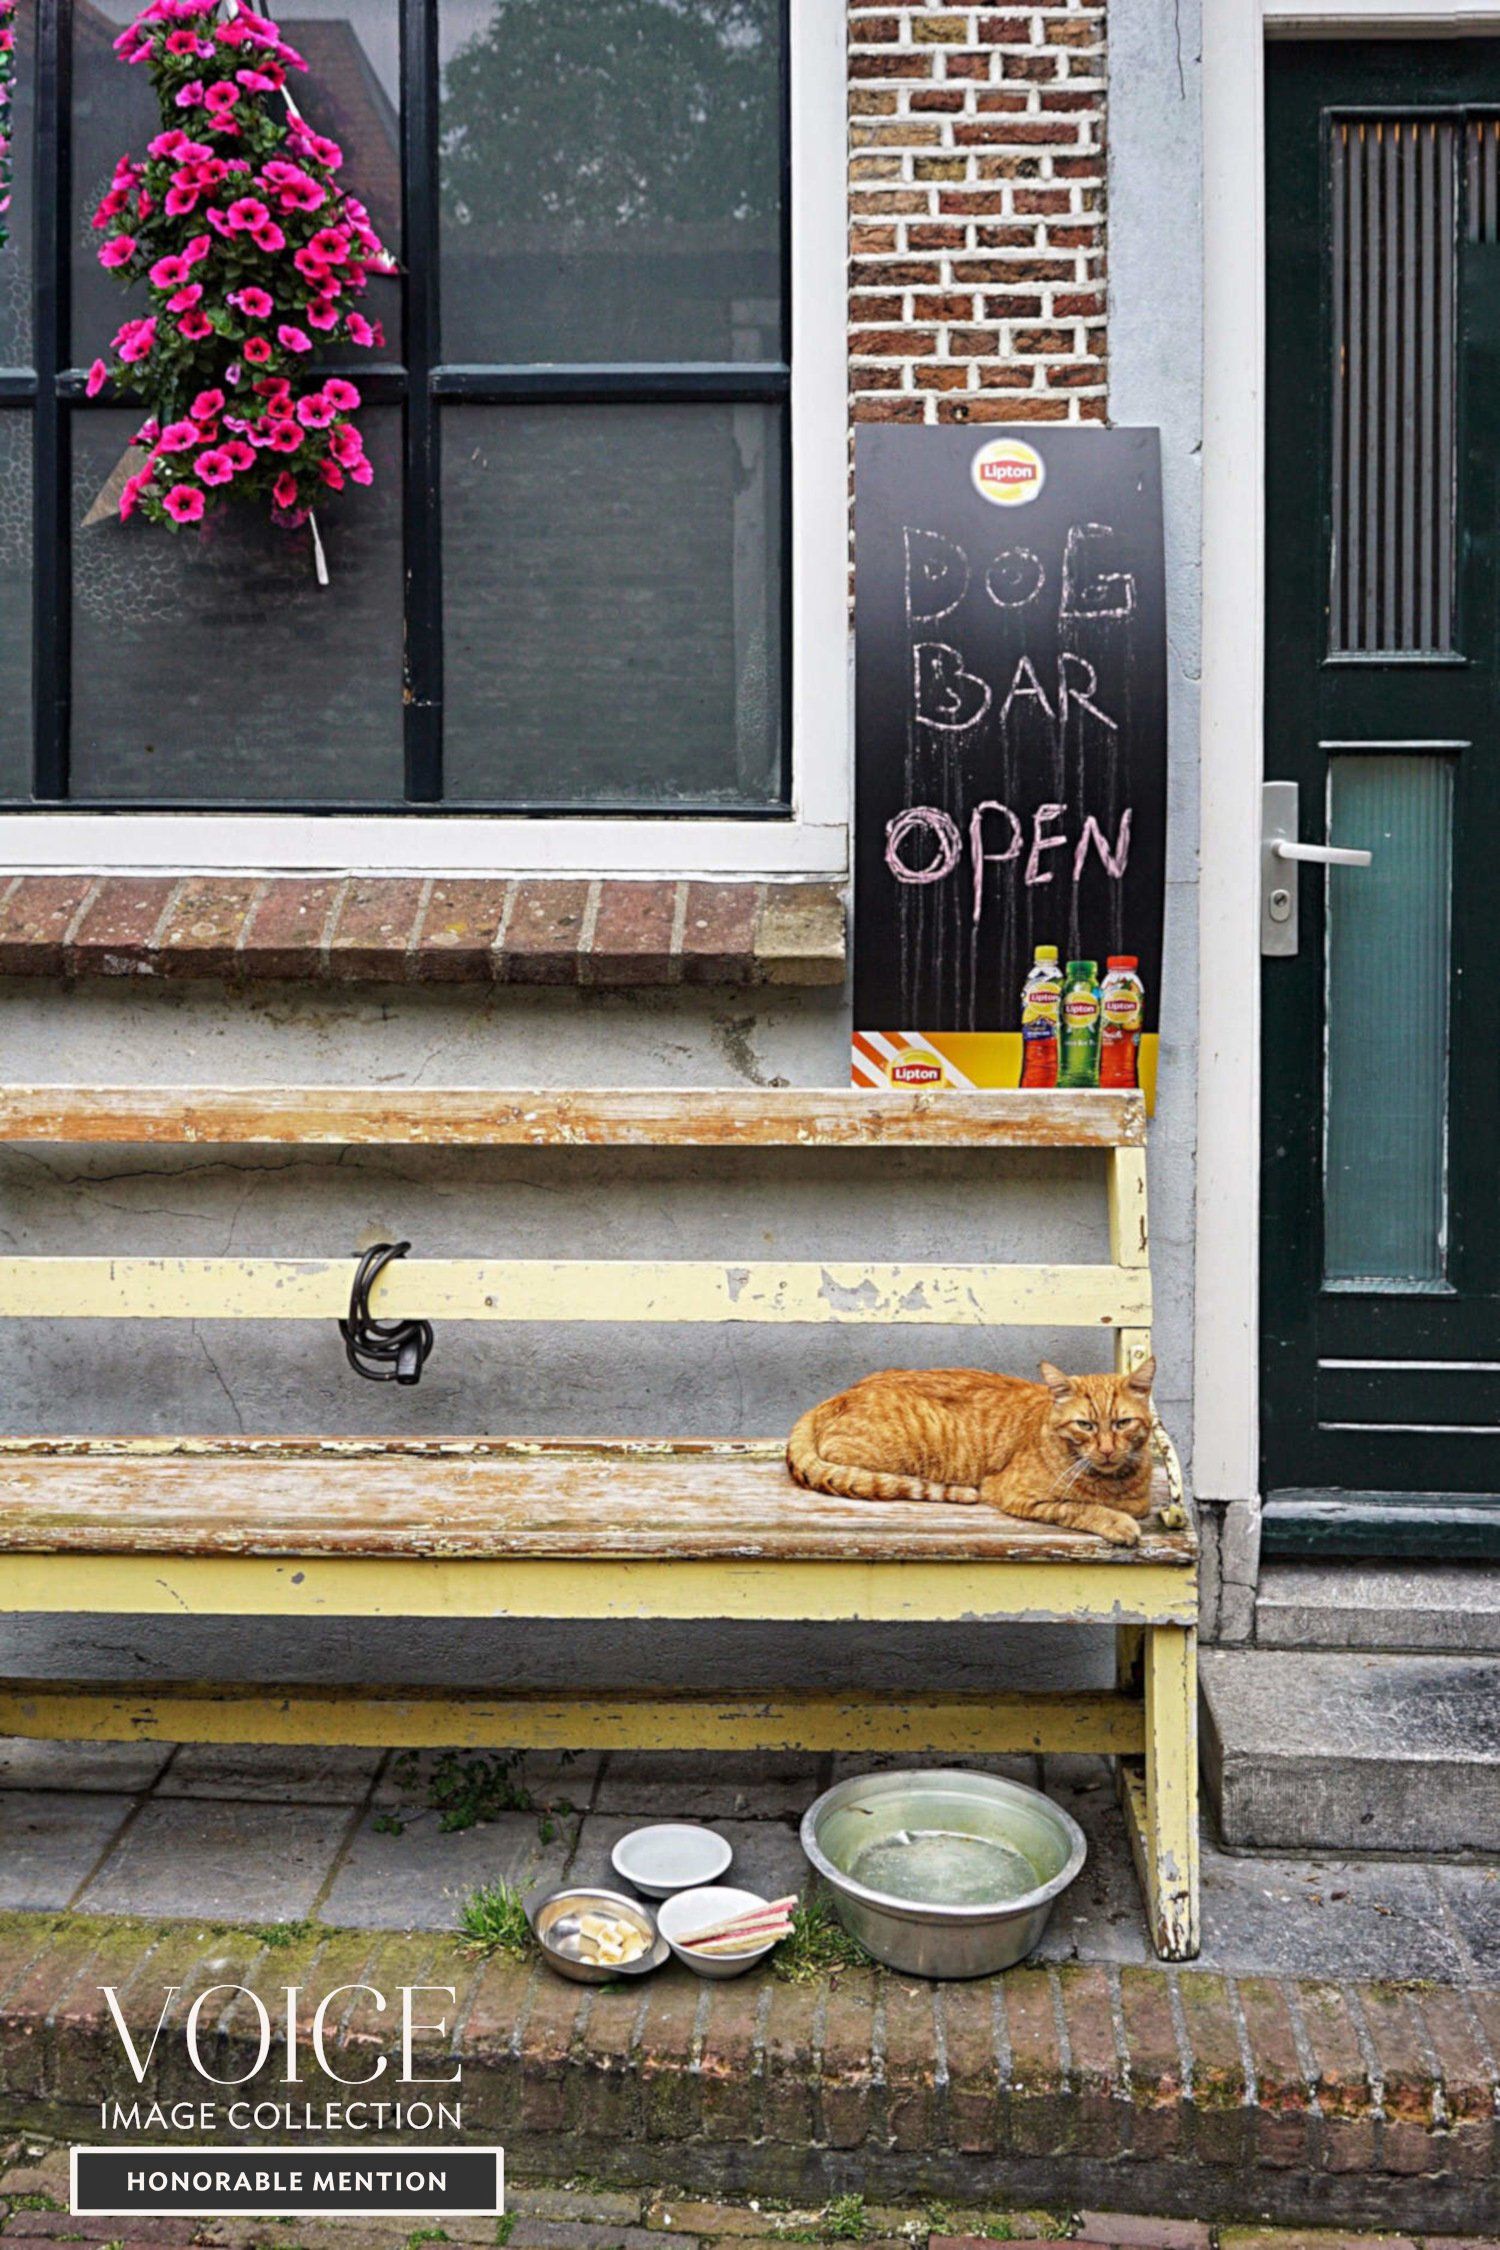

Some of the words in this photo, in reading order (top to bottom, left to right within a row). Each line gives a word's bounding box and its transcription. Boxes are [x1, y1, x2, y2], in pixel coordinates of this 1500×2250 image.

[984, 464, 1032, 480] Lipton
[913, 641, 1118, 731] BAR
[884, 800, 1133, 922] OPEN
[1065, 1005, 1095, 1015] Lipton
[1105, 1002, 1135, 1012] Lipton
[895, 1068, 938, 1081] Lipton
